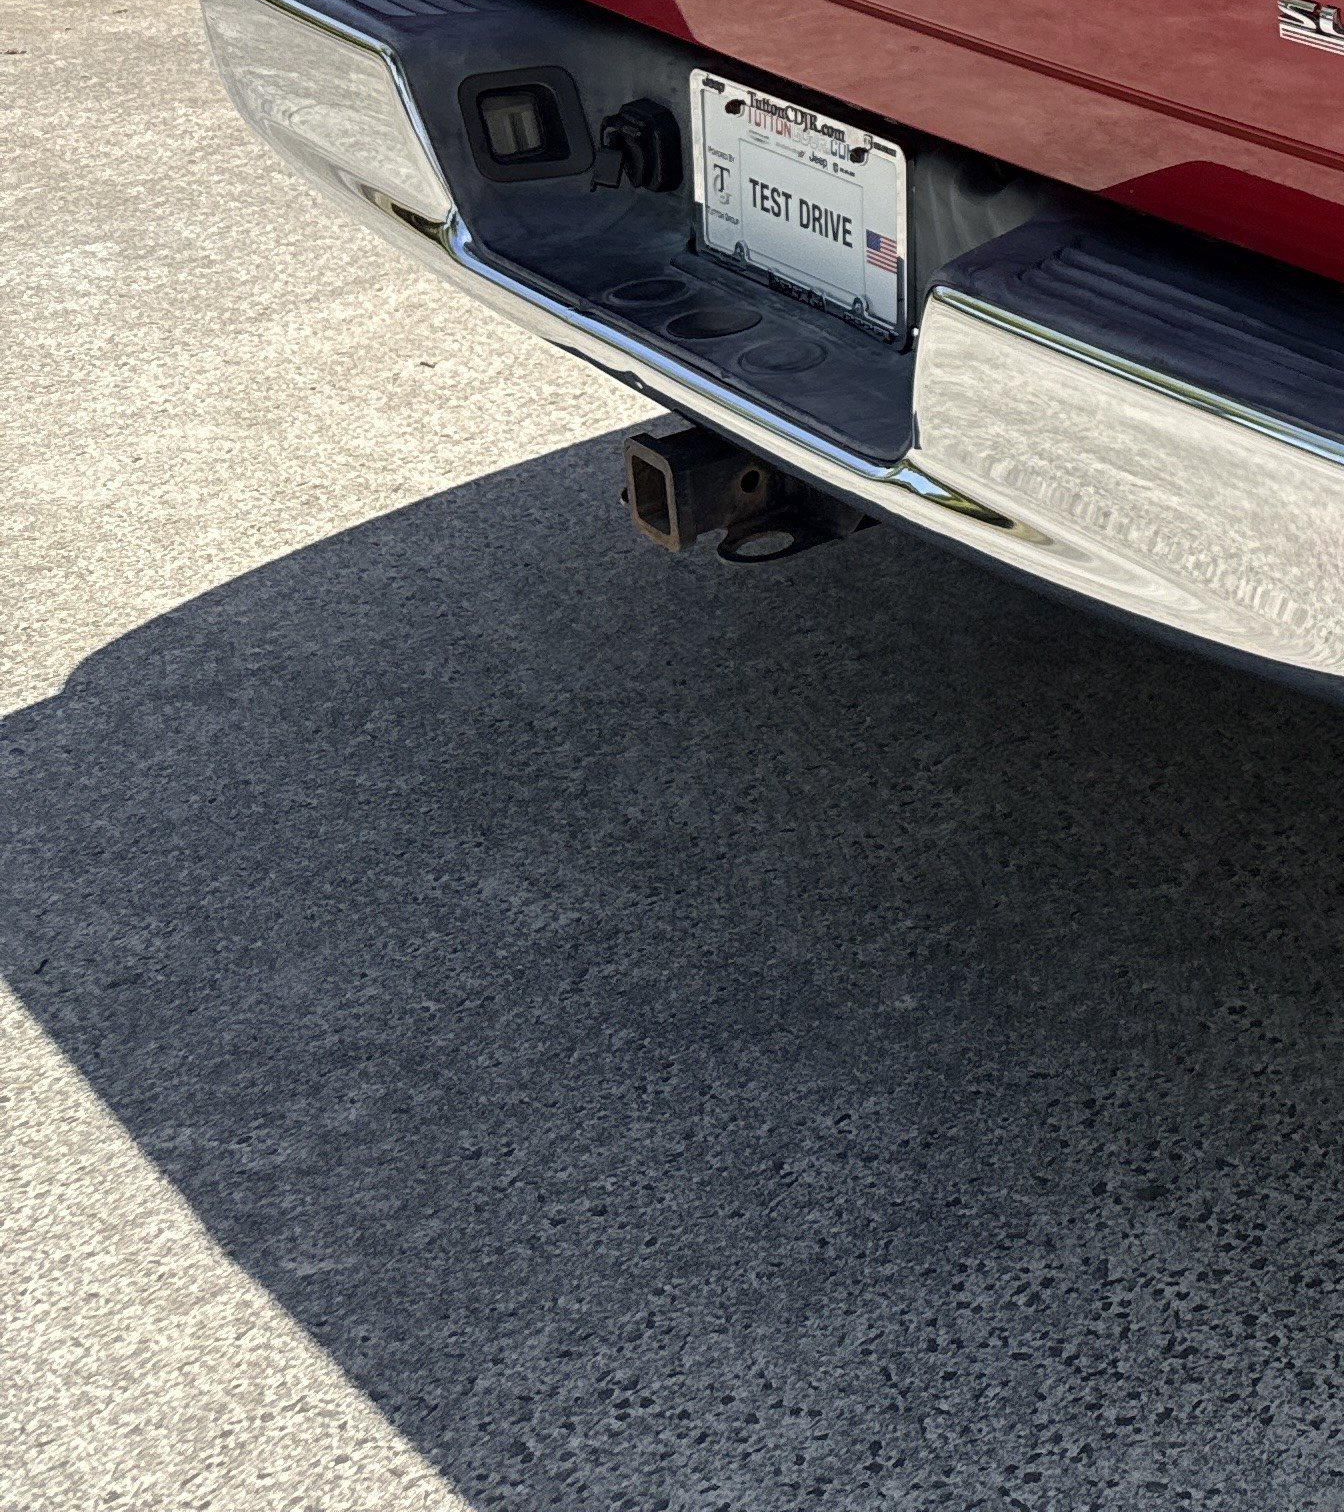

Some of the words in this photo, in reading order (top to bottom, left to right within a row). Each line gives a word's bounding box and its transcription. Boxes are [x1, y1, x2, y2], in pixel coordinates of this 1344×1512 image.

[702, 73, 725, 94] Jeep
[746, 90, 846, 142] TuttonCDJR.com
[808, 151, 828, 170] Jeep
[749, 177, 793, 223] TEST
[799, 197, 854, 248] DRIVE
